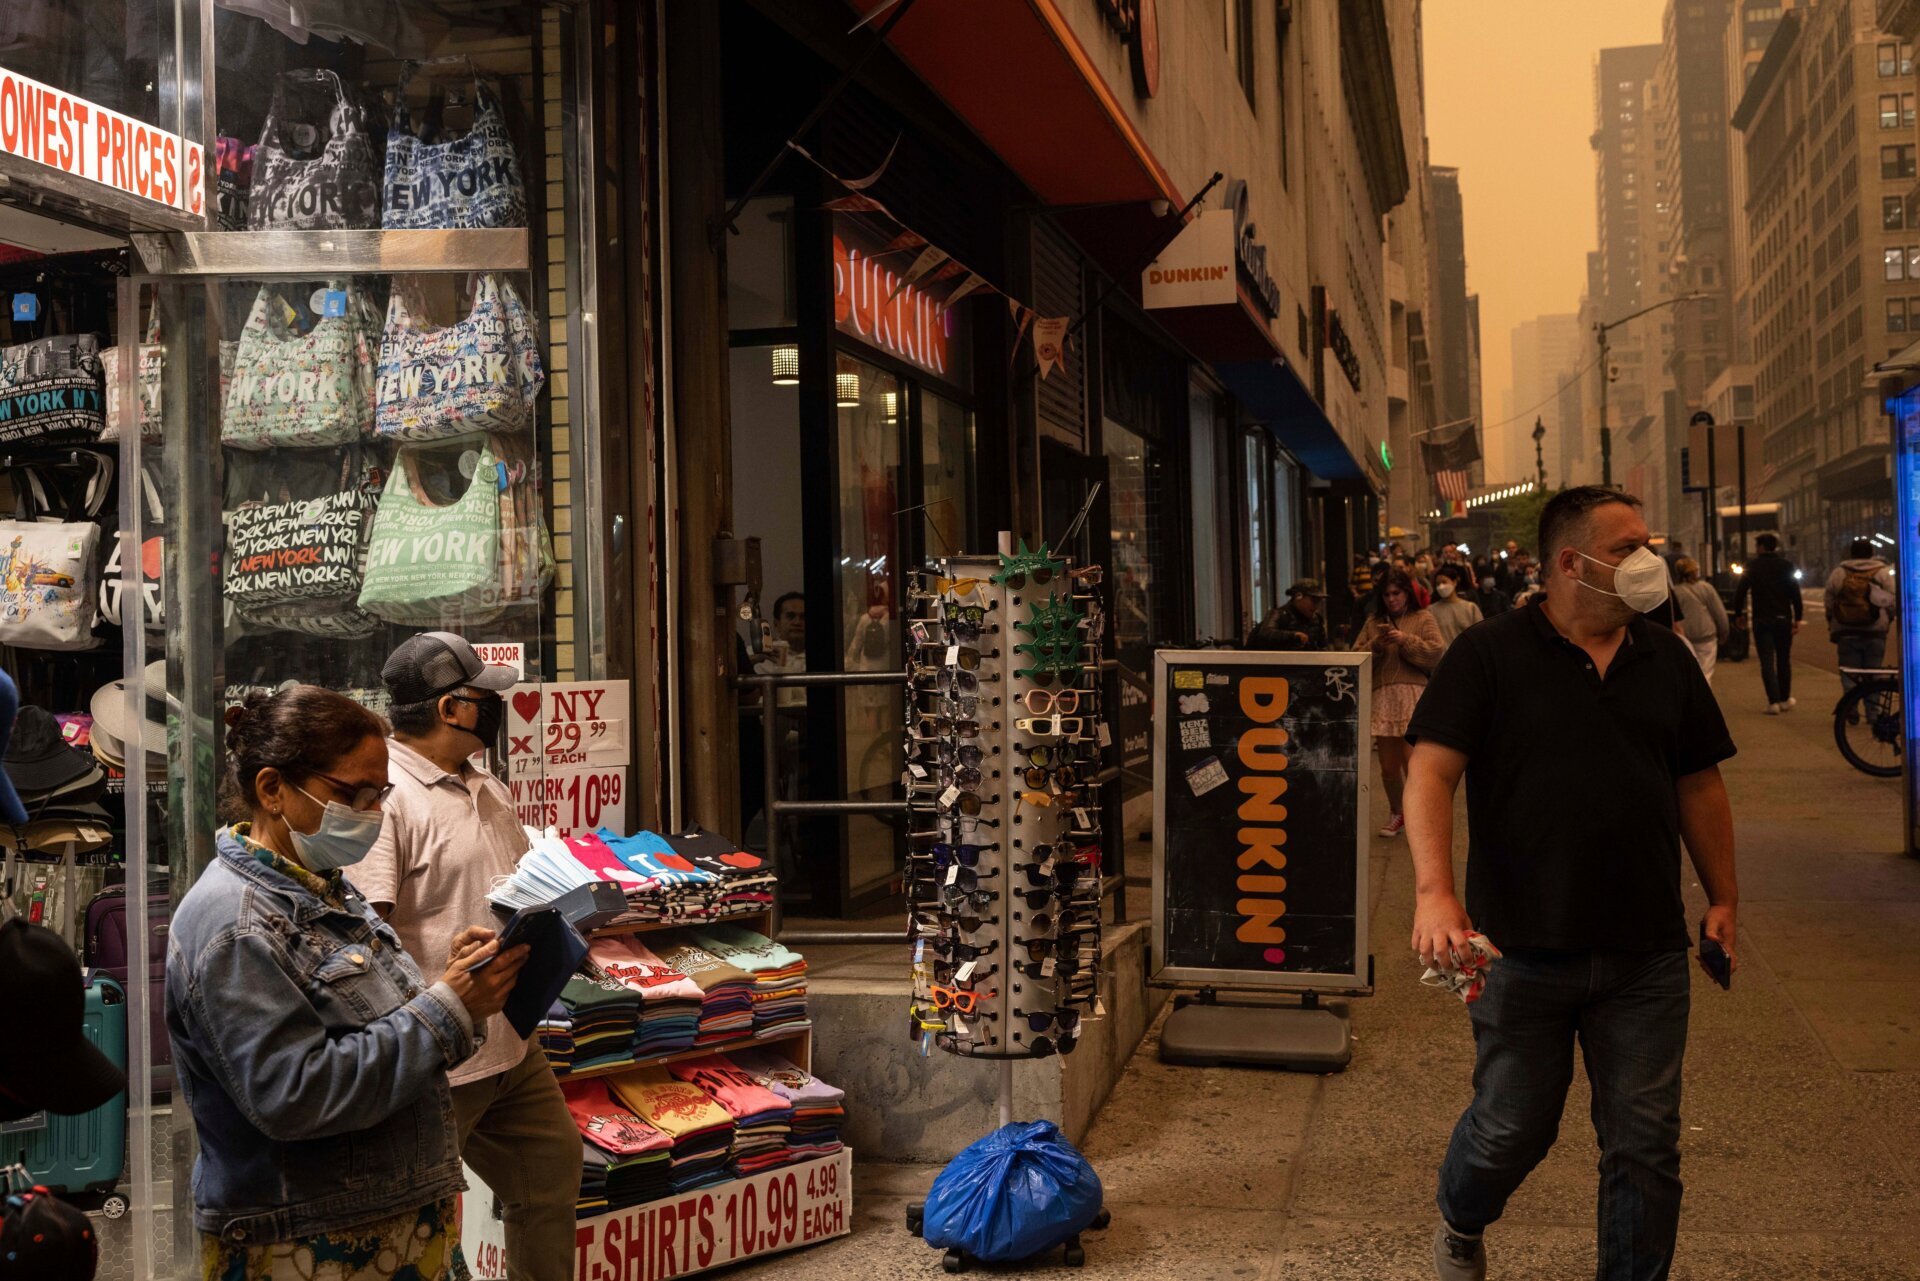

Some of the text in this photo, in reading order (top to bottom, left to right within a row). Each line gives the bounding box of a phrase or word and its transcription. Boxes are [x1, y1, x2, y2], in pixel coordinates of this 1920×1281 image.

[97, 111, 177, 205] PRICES
[436, 157, 514, 198] YORK
[1149, 266, 1228, 285] DUNKIN'
[37, 379, 53, 387] YORK
[263, 370, 340, 404] YORK
[431, 353, 508, 395] YORK
[15, 389, 66, 417] YORK
[254, 502, 289, 524] NEW
[267, 514, 301, 535] NEW
[466, 515, 492, 525] YORK
[249, 533, 290, 556] YORK
[291, 525, 329, 546] NEW
[411, 531, 490, 564] YORK
[240, 550, 276, 572] NEW
[277, 546, 323, 567] YORK
[255, 567, 291, 590] NEW
[292, 565, 340, 585] YORK
[390, 575, 408, 583] YORK
[428, 572, 446, 580] YORK
[491, 646, 519, 662] DOOR
[550, 689, 605, 723] NY
[545, 723, 581, 754] 29
[590, 721, 607, 738] 99
[515, 758, 528, 773] 17
[551, 752, 587, 765] EACH
[527, 778, 564, 802] YORK
[1236, 677, 1289, 964] DUNKIN'
[605, 963, 642, 979] New
[576, 1164, 838, 1281] T-SHIRTS 10.99 4.99
[803, 1199, 844, 1242] EACH
[476, 1240, 498, 1278] 4.99
